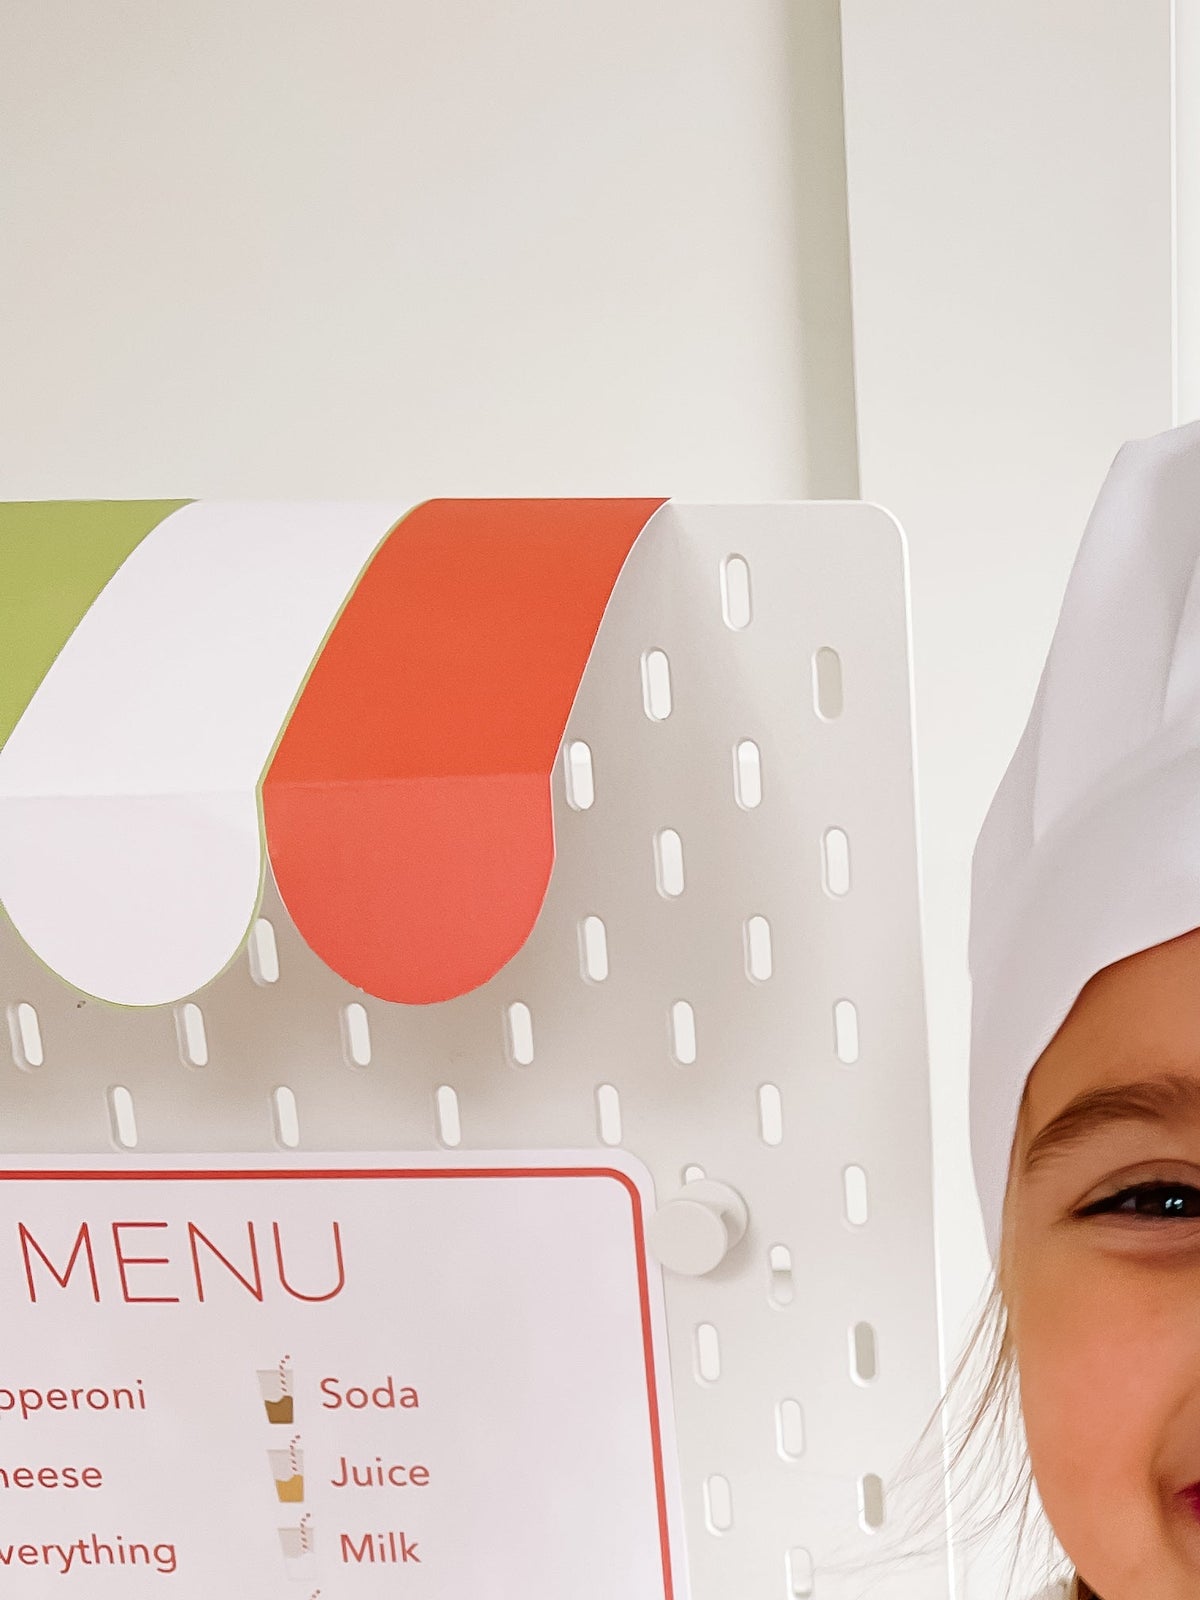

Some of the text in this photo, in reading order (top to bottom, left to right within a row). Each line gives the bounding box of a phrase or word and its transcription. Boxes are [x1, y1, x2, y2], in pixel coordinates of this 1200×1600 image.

[17, 1220, 346, 1304] MENU
[319, 1376, 420, 1410] Soda
[331, 1456, 430, 1488] Juice
[340, 1532, 421, 1563] Milk
